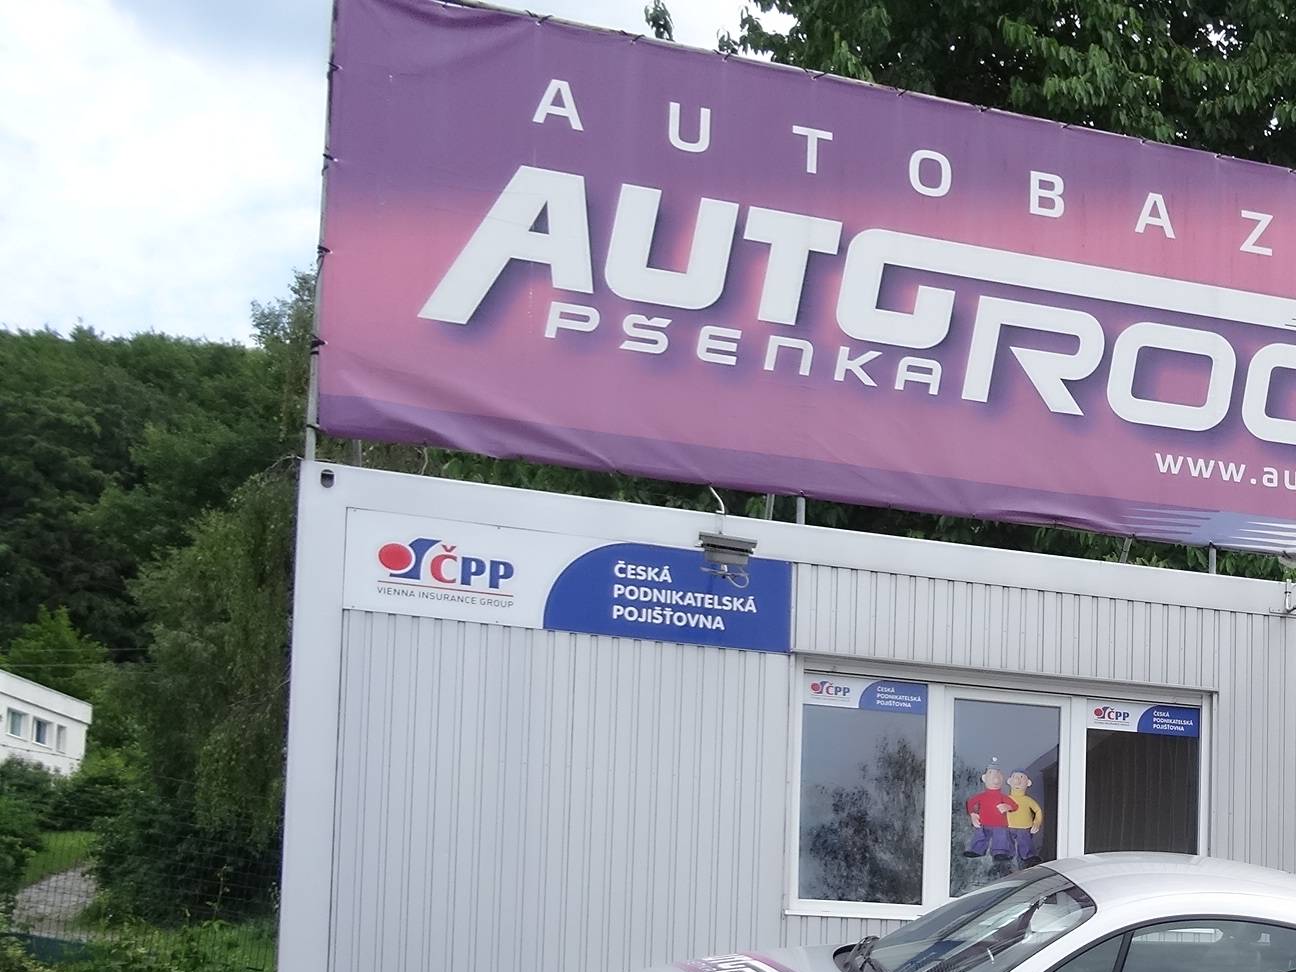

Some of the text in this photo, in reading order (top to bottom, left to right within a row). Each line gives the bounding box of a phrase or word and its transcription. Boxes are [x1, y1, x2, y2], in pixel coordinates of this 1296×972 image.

[430, 544, 515, 590] ČPP
[613, 560, 673, 583] ČESKÁ
[377, 586, 515, 609] VIENNA INSURANCE GROUP
[613, 584, 758, 613] PODNIKATELSKÁ
[612, 605, 726, 631] POJIŠŤOVNA
[825, 682, 851, 697] ČPP
[1107, 708, 1131, 721] ČPP
